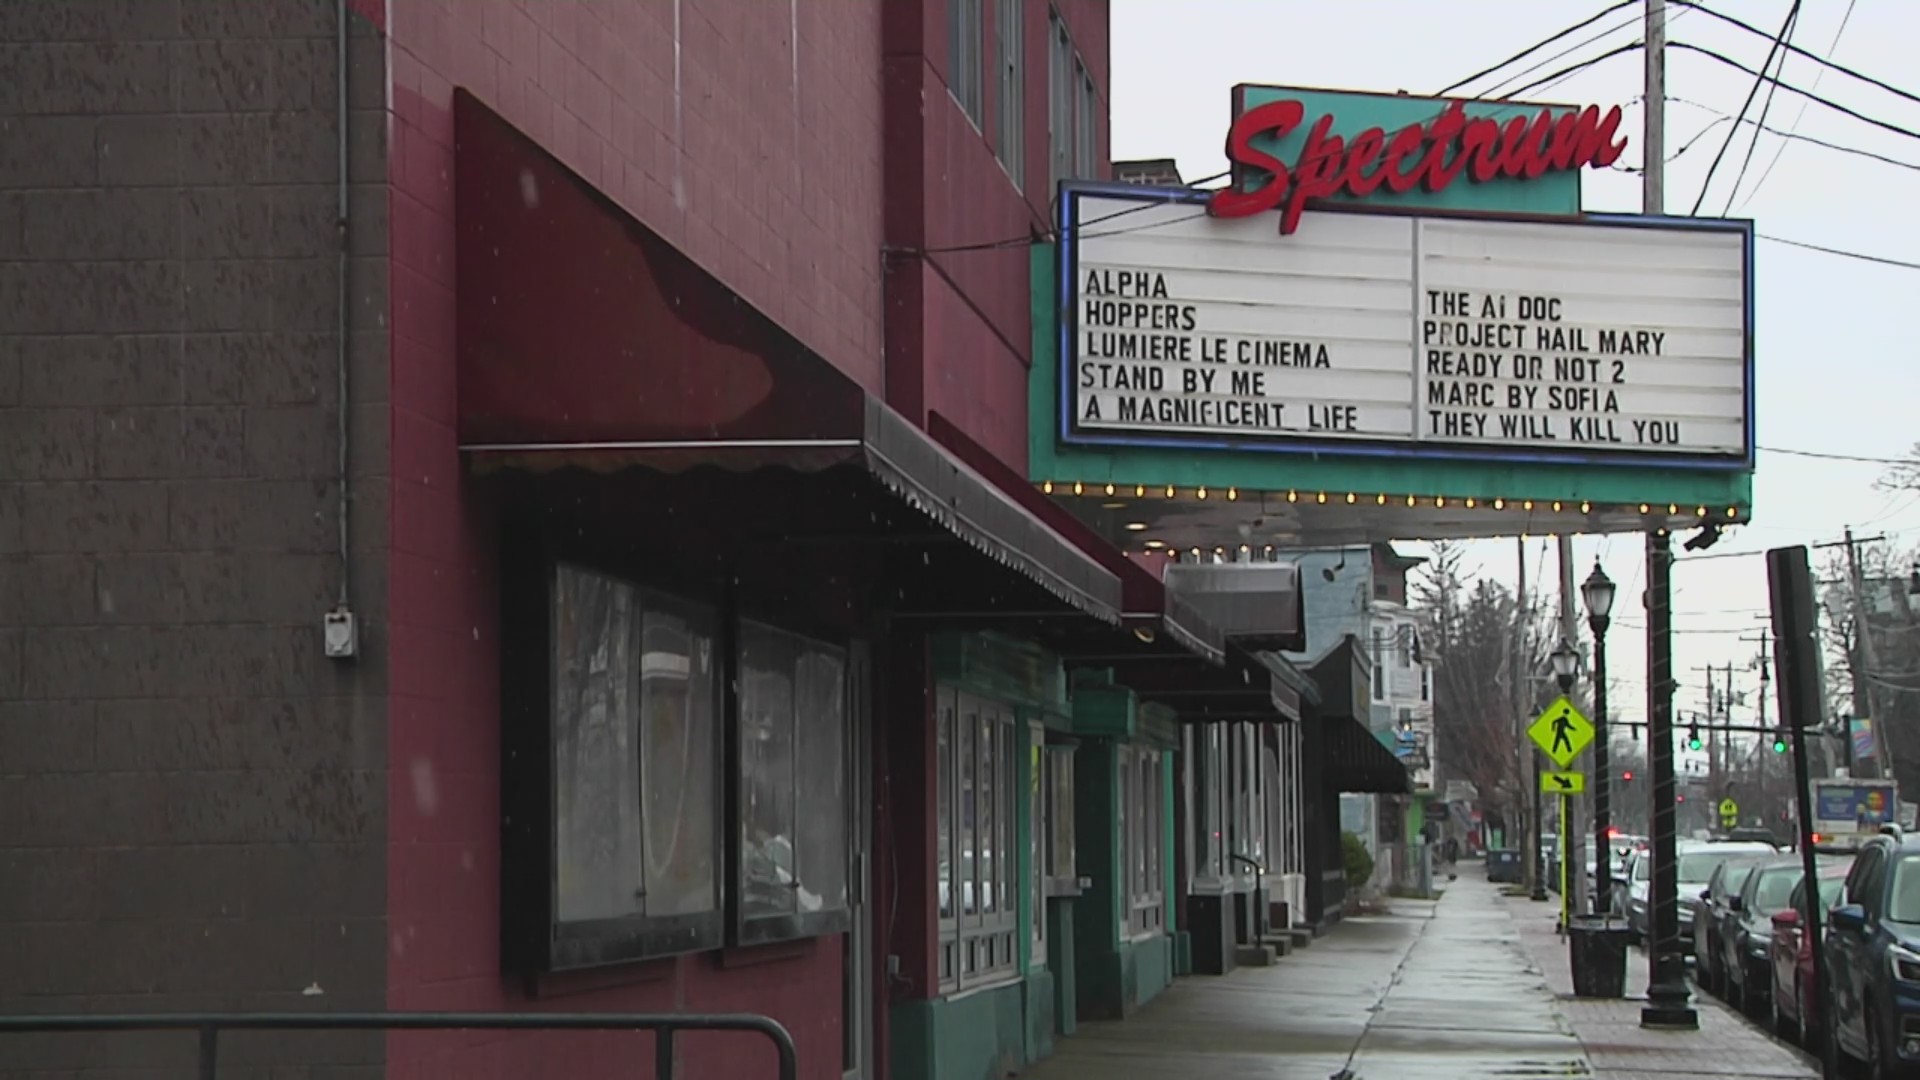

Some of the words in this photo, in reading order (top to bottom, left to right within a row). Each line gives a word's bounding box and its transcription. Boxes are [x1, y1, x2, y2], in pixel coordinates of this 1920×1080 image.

[1207, 99, 1627, 235] Spectrum
[1086, 269, 1168, 298] ALPHA
[1086, 301, 1196, 330] HOPPERS
[1428, 291, 1469, 316] THE
[1519, 297, 1562, 321] DOC
[1087, 332, 1191, 361] LUMIERE
[1201, 338, 1227, 363] LE
[1237, 340, 1330, 368] CINEMA
[1424, 321, 1526, 348] PROJECT
[1537, 328, 1588, 352] HAIL
[1599, 331, 1665, 356] MARY
[1082, 363, 1163, 391] STAND
[1183, 369, 1216, 393] BY
[1232, 371, 1265, 396] ME
[1428, 351, 1502, 378] READY
[1514, 355, 1542, 380] OR
[1556, 358, 1600, 382] NOT
[1612, 361, 1625, 383] 2
[1085, 395, 1100, 419] A
[1119, 396, 1284, 427] MAGNIFICENT
[1309, 405, 1357, 430] LIFE
[1429, 381, 1494, 407] MARC
[1509, 386, 1537, 409] BY
[1549, 387, 1619, 413] SOFIA
[1430, 411, 1487, 437] THEY
[1500, 414, 1555, 439] WILL
[1571, 417, 1620, 442] KILL
[1633, 420, 1679, 444] YOU
